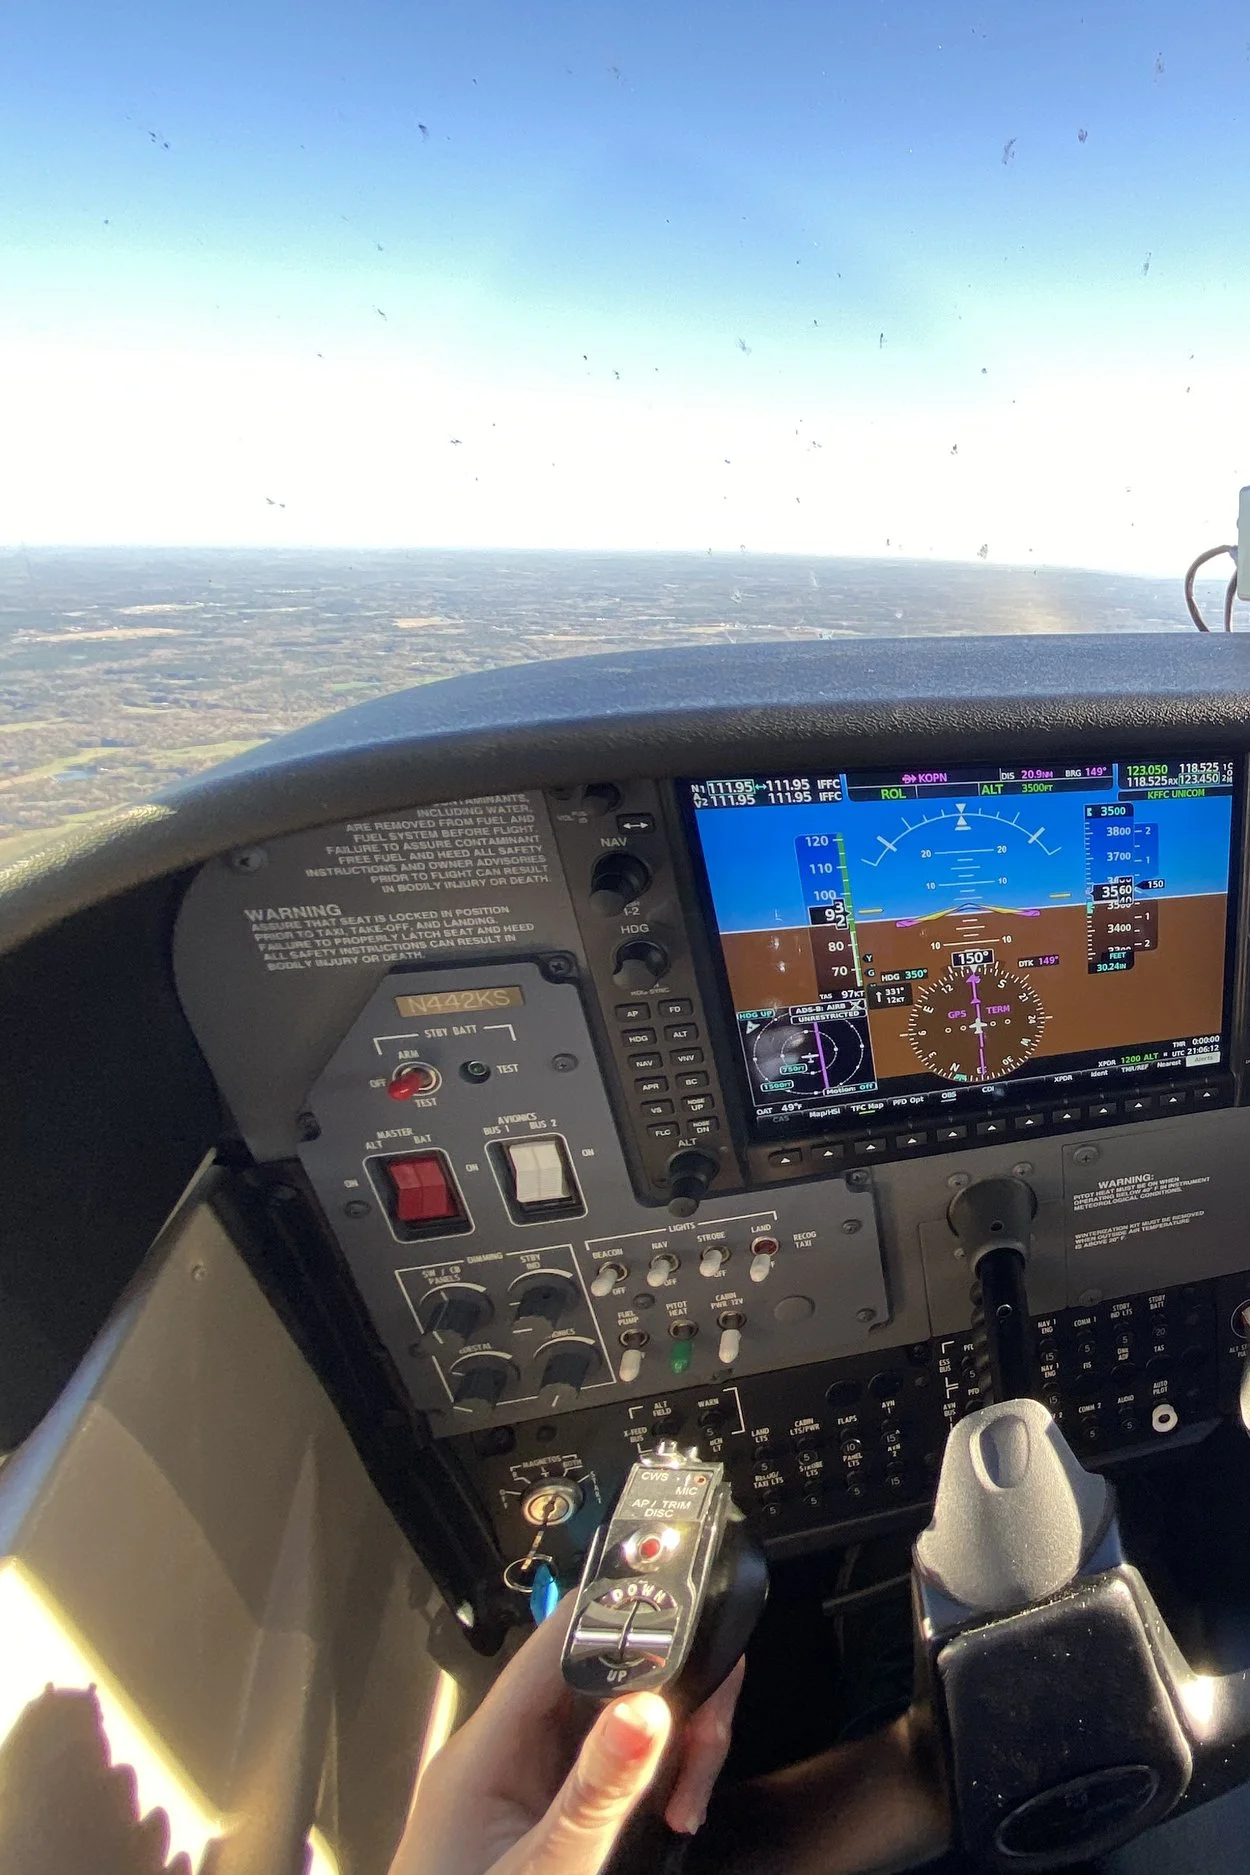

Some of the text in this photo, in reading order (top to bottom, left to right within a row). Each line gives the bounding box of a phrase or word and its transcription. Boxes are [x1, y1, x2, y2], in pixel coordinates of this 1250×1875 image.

[1065, 766, 1107, 777] BRG 149°
[1127, 762, 1219, 776] 123.050 118.525
[918, 773, 948, 783] KOPN
[1001, 771, 1015, 780] DIS
[1179, 774, 1219, 784] 123.450
[708, 780, 840, 794] 111.95 111.95 IFFC
[981, 784, 1053, 796] ALT 3500FT
[881, 788, 906, 799] ROL
[1147, 788, 1205, 799] KFFC UNICOM
[711, 792, 842, 807] 111.95 111.95 IFFC
[1100, 807, 1126, 816] 3500
[1106, 827, 1131, 836] 3800
[601, 838, 627, 847] NAV
[805, 836, 829, 847] 120
[1107, 852, 1131, 861] 3700
[306, 855, 546, 877] INSTRUCTIONS AND OWNER ADVISORIES
[809, 863, 833, 874] 110
[371, 864, 549, 884] PRIOR TO FLIGHT CAN RESULT
[382, 884, 394, 893] IN
[397, 881, 440, 893] BODILY
[444, 878, 486, 890] INJURY
[490, 876, 507, 886] OR
[1147, 880, 1163, 888] 150
[814, 890, 836, 900] 100
[245, 904, 342, 922] WARNING
[621, 924, 649, 934] HDG
[1107, 923, 1131, 933] 3400
[828, 941, 844, 952] 80
[958, 951, 989, 965] 150°
[1019, 956, 1059, 968] DTK 149°
[832, 967, 848, 976] 70
[882, 969, 927, 982] HDG 350°
[409, 990, 510, 1012] N442KS
[627, 1010, 638, 1018] AP
[798, 1010, 860, 1022] UNRESTRICTED
[948, 1005, 1010, 1019] GPS TERM
[424, 1025, 477, 1038] STBY BATT
[673, 1030, 688, 1038] ALT
[629, 1035, 648, 1043] HDG
[1192, 1035, 1220, 1045] 0:00:00
[398, 1050, 419, 1059] ARM
[1172, 1045, 1219, 1058] UTC 21:06:12
[1098, 1052, 1158, 1067] XPDR 1200 ALT
[1157, 1059, 1181, 1068] Nearest
[496, 1064, 519, 1074] TEST
[826, 1082, 874, 1095] Motion: Off
[415, 1098, 437, 1107] TEST
[893, 1096, 924, 1106] PFD Opt
[851, 1103, 884, 1112] TFC Map
[810, 1108, 840, 1118] Map/HSI
[498, 1113, 537, 1125] AVIONICS
[376, 1128, 413, 1139] MASTER
[413, 1134, 432, 1144] BAT
[678, 1137, 698, 1147] ALT
[366, 1141, 383, 1150] ALT
[1099, 1174, 1154, 1188] WARNING:
[669, 1222, 696, 1232] LIGHTS
[751, 1224, 771, 1233] LAND
[697, 1232, 726, 1242] STROBE
[793, 1231, 816, 1241] RECOG
[652, 1241, 668, 1250] NAV
[795, 1240, 812, 1248] TAXI
[592, 1248, 623, 1259] BEACON
[716, 1292, 736, 1301] CABIN
[666, 1301, 687, 1310] PITOT
[711, 1301, 727, 1309] PWR
[618, 1310, 635, 1319] FUEL
[669, 1308, 688, 1316] HEAT
[618, 1317, 639, 1325] PUMP
[698, 1398, 719, 1408] WARN
[838, 1415, 858, 1425] FLAPS
[752, 1427, 770, 1437] LAND
[641, 1471, 669, 1482] CWS
[676, 1486, 698, 1496] MIC
[662, 1500, 691, 1510] TRIM
[644, 1508, 674, 1518] DISC
[612, 1584, 666, 1604] DOWN
[606, 1670, 627, 1682] UP
